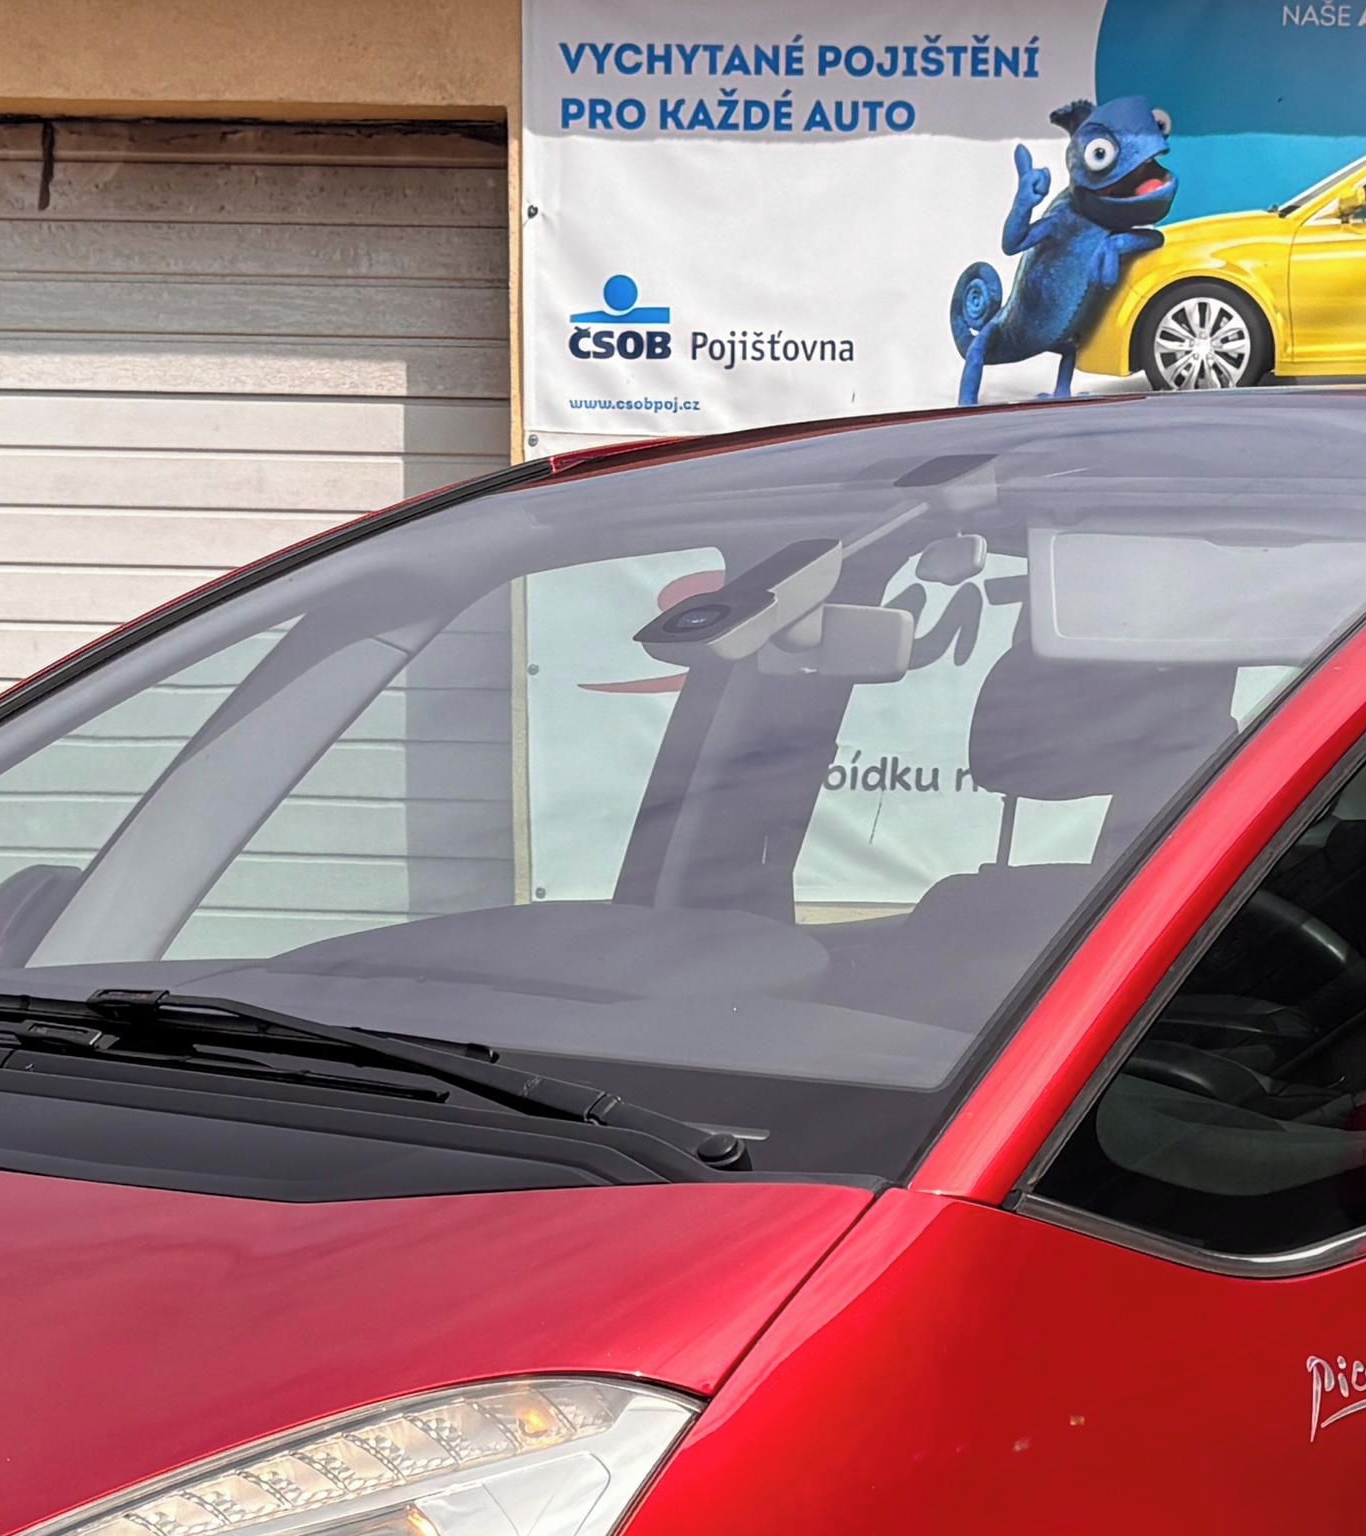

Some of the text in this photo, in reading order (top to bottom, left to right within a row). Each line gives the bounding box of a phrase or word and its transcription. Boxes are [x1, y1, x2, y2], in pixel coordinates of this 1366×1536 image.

[559, 34, 1040, 78] VYCHYTANÉ POJIŠTĚNÍ
[561, 87, 916, 132] PRO KAŽDÉ AUTO
[568, 326, 855, 370] ČSOB Pojišťovna
[569, 396, 701, 413] www.csobpoj.cz
